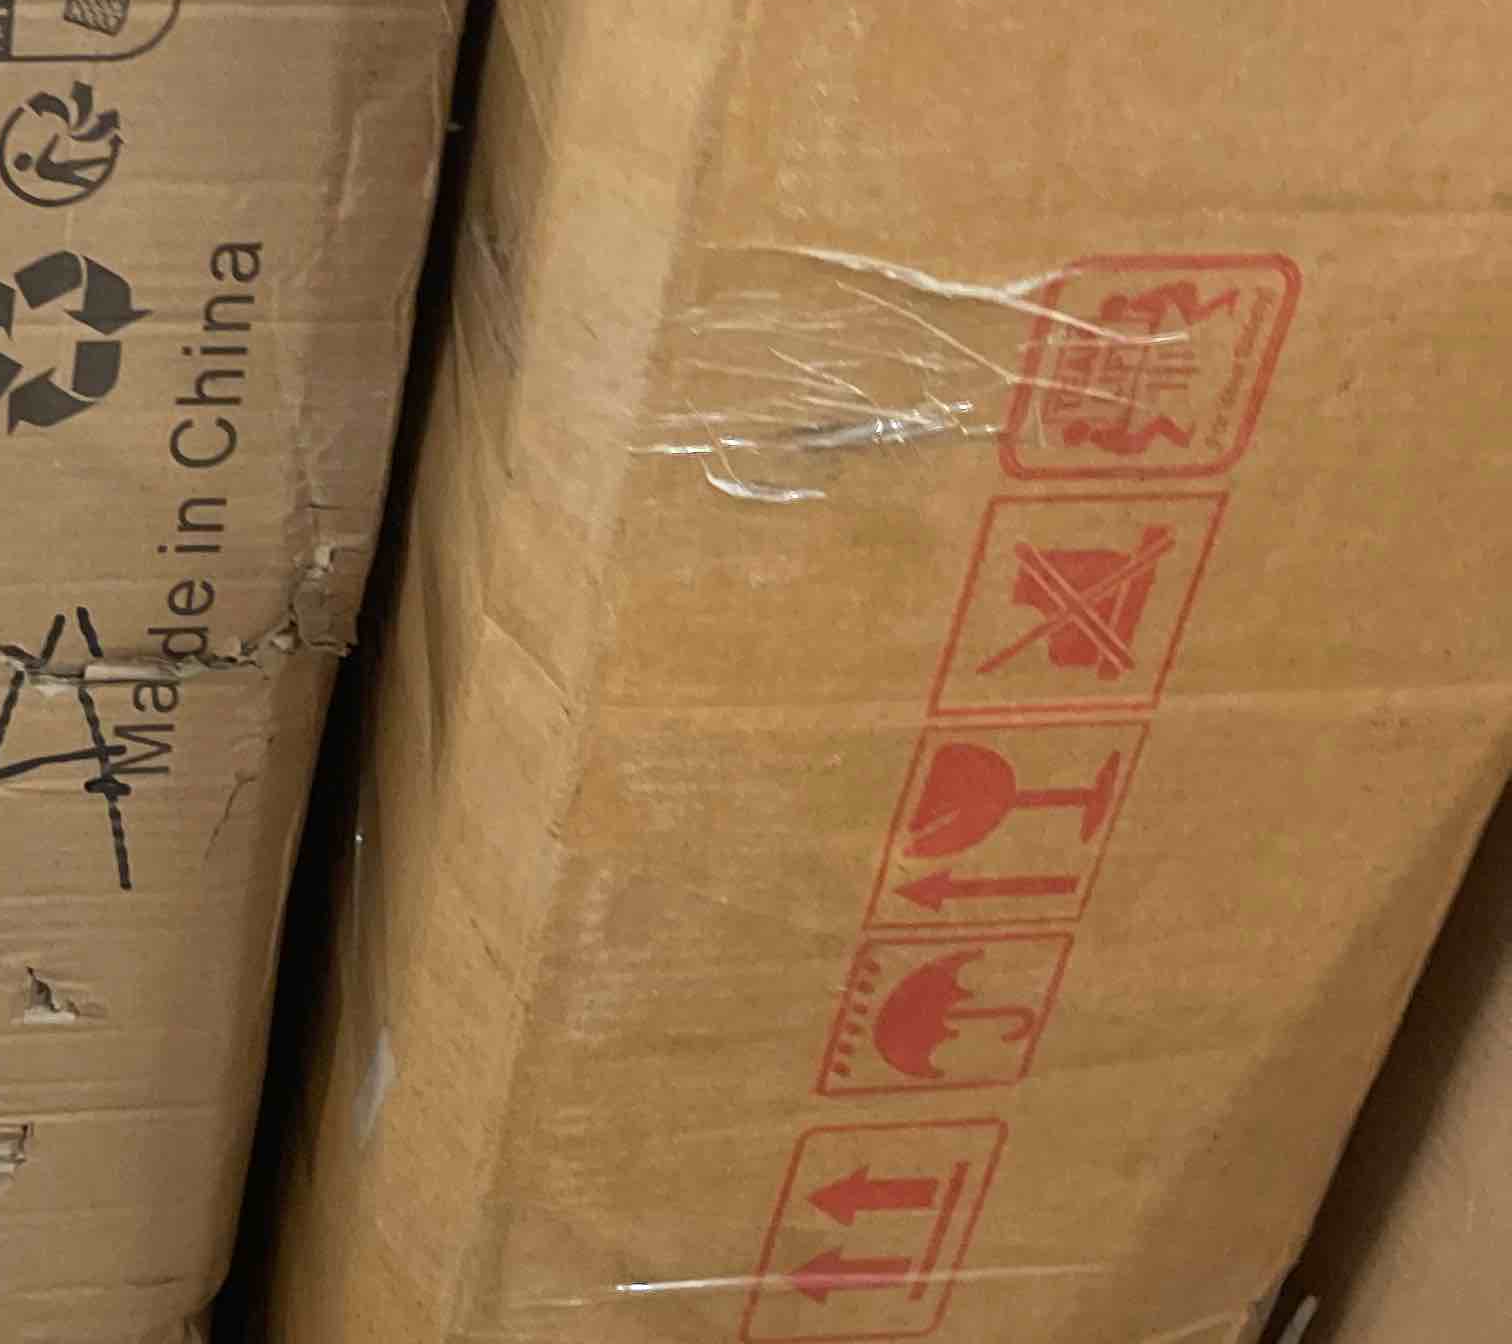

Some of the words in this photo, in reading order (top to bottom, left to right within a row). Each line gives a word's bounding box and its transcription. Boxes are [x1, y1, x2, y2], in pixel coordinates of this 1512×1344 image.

[172, 240, 263, 470] China
[158, 499, 227, 558] in
[113, 580, 217, 778] Made
